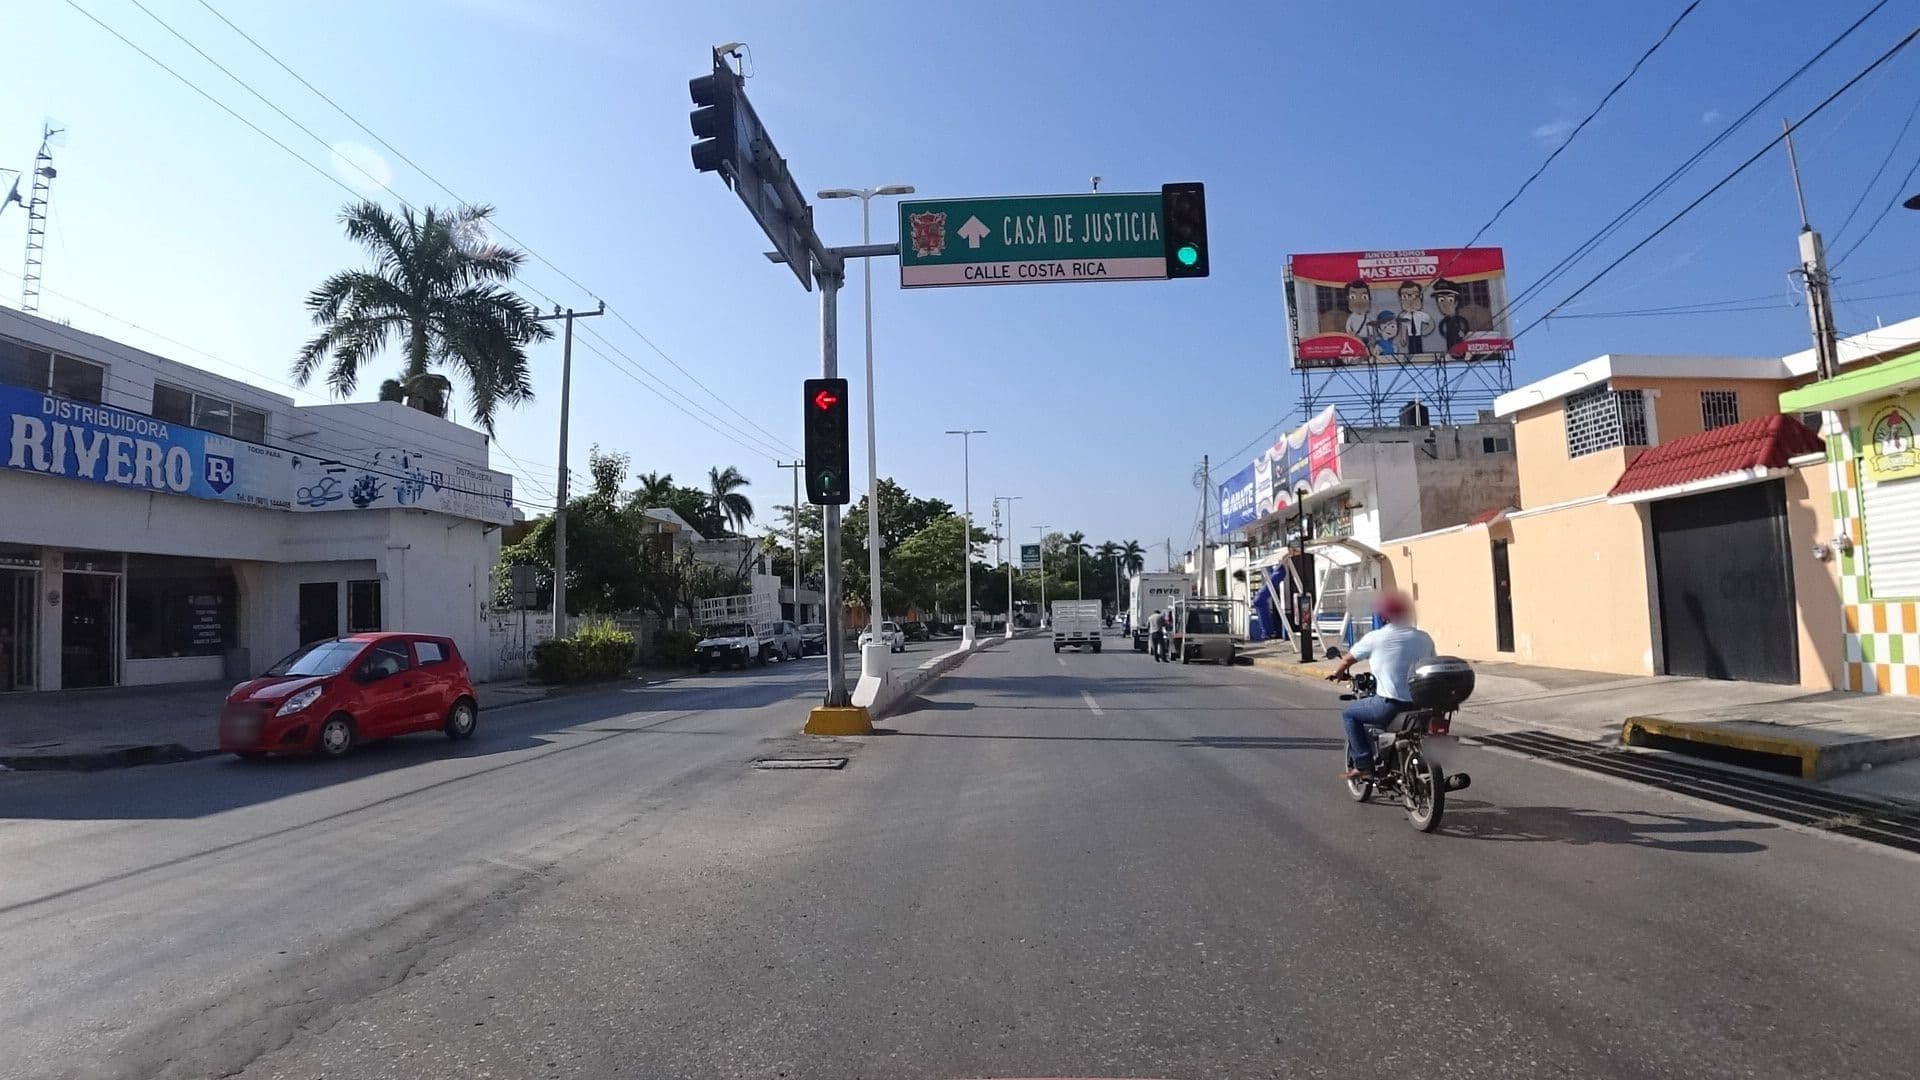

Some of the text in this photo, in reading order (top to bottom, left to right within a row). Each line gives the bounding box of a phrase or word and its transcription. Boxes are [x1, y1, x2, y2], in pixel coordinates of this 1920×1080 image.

[1004, 212, 1159, 246] CASA DE JUSTICIA
[1365, 251, 1395, 259] JUNTOS
[965, 262, 1107, 280] CALLE COSTA RICA
[1388, 265, 1437, 277] SEGURO
[42, 397, 169, 440] DISTRIBUIDORA
[8, 414, 193, 493] RIVERO
[207, 457, 232, 484] R
